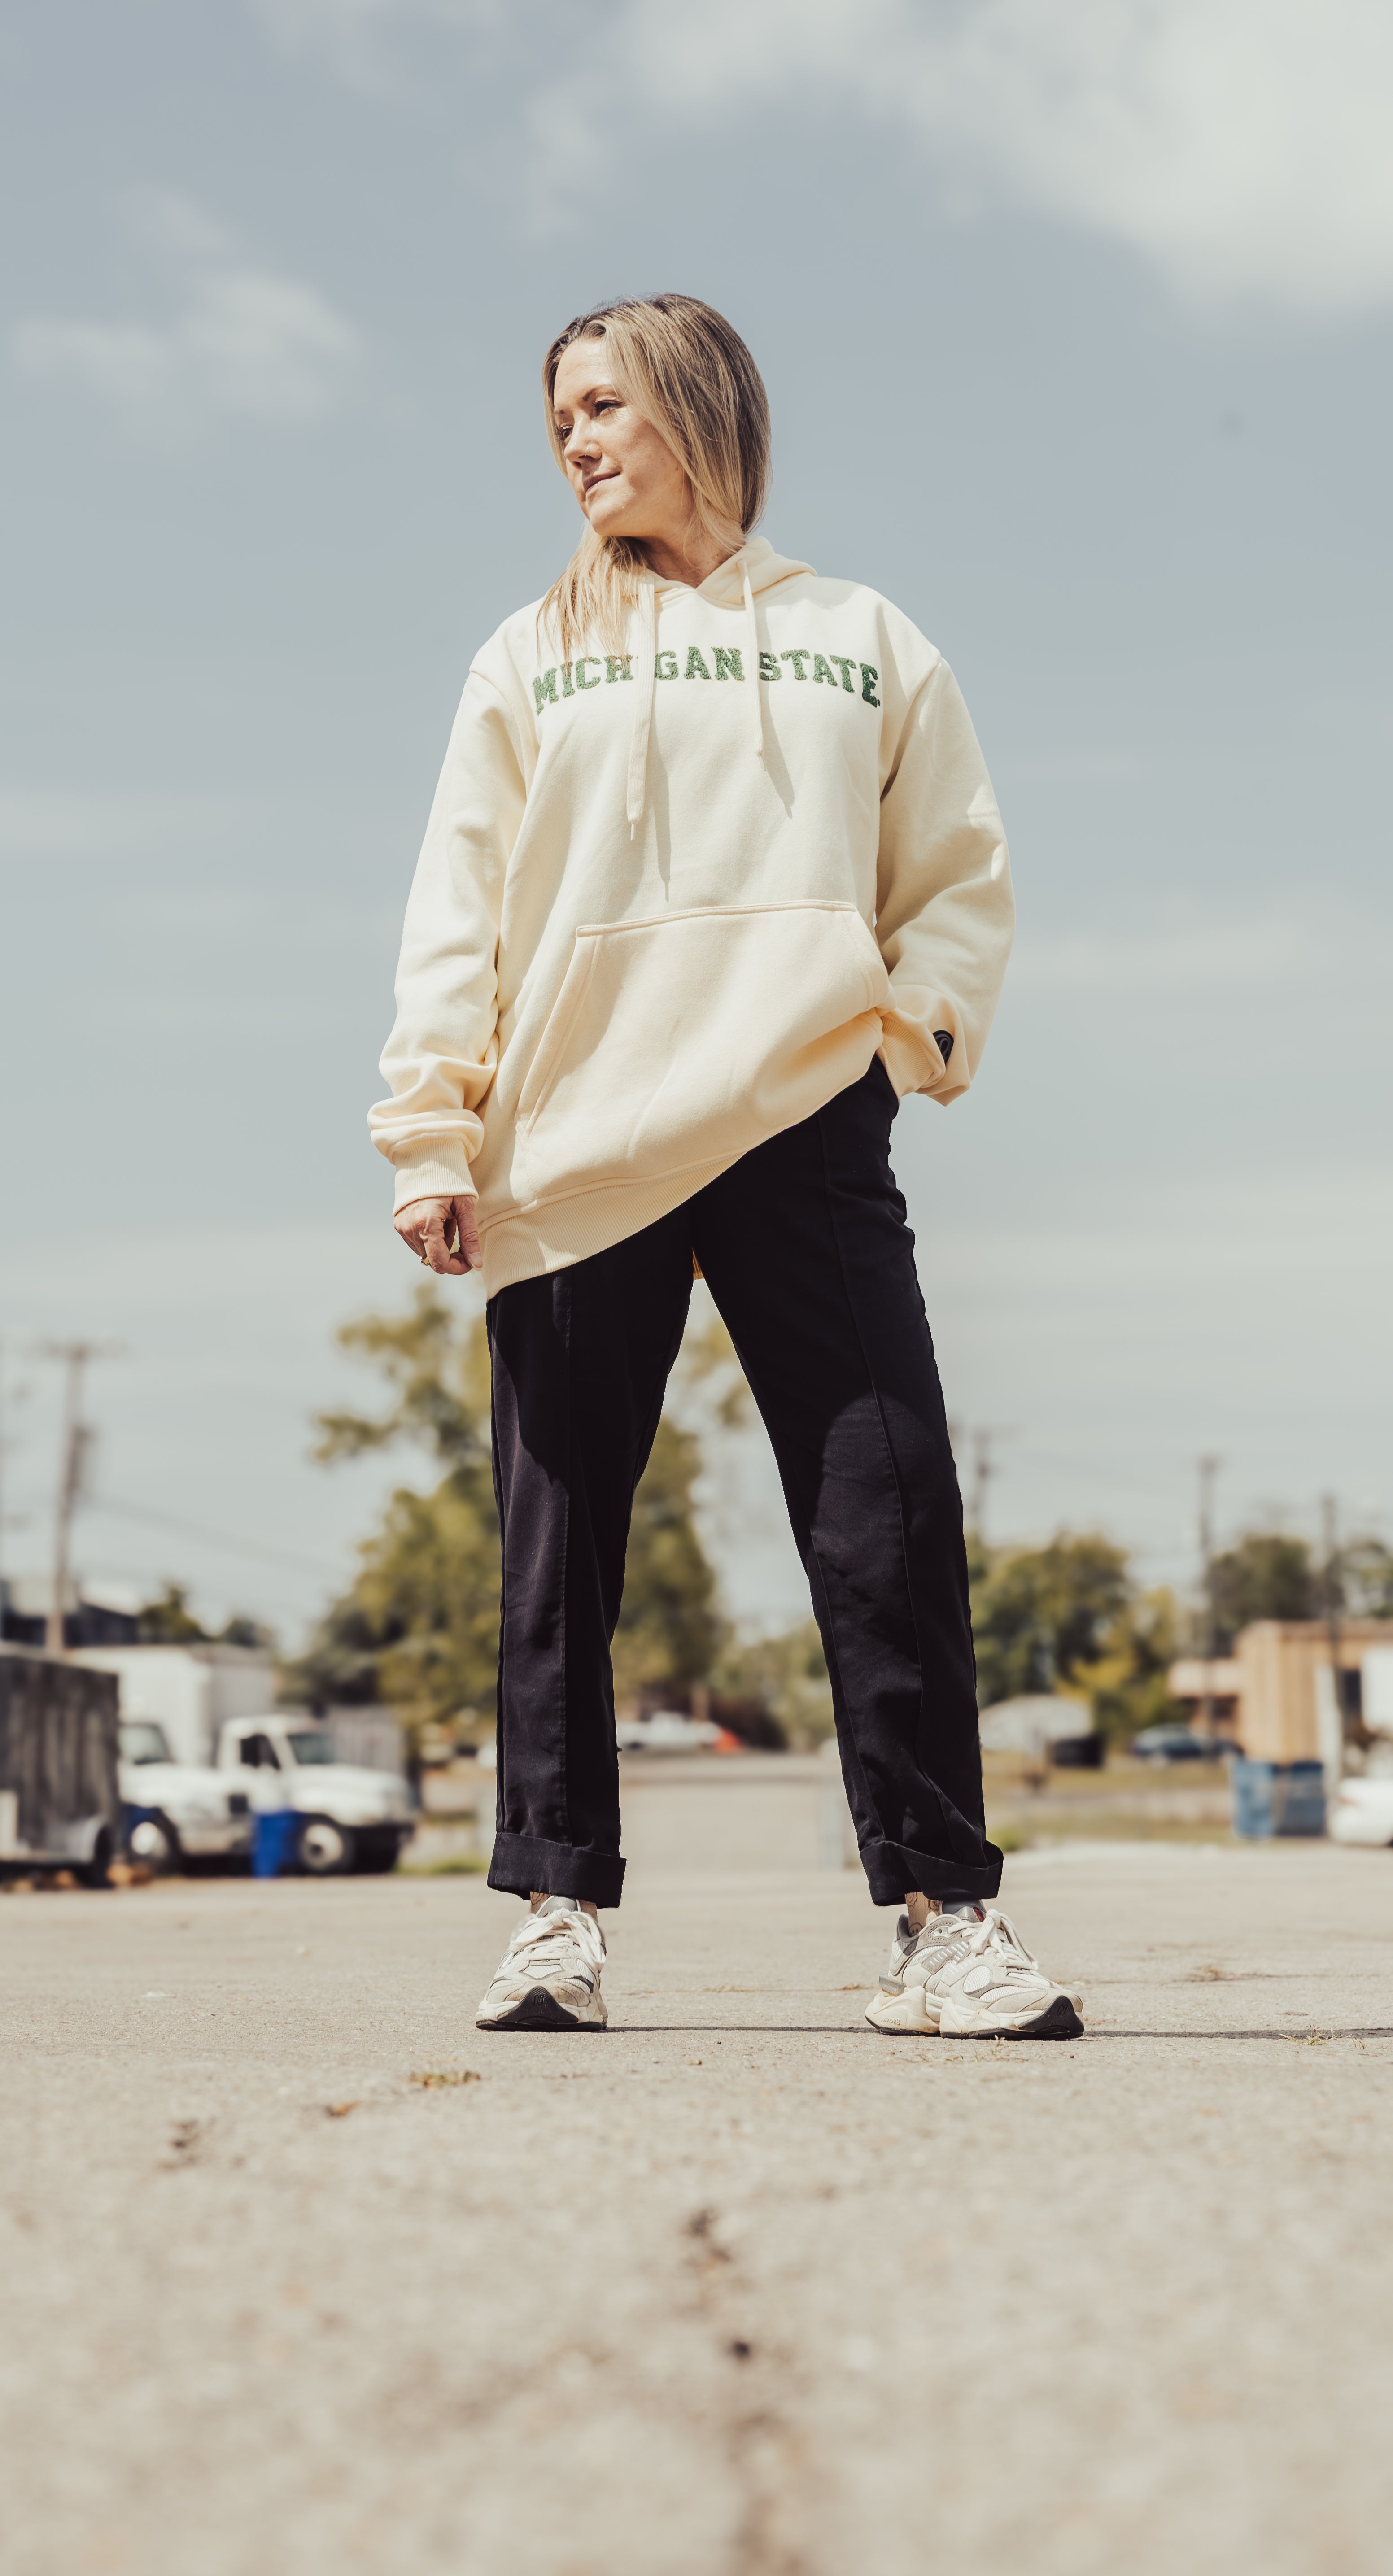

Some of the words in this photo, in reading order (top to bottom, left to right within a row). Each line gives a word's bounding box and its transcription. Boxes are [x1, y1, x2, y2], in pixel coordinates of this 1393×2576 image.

[532, 646, 745, 717] MICHGAN
[759, 649, 881, 708] STATE
[534, 1994, 545, 2006] N
[1056, 2005, 1068, 2015] N
